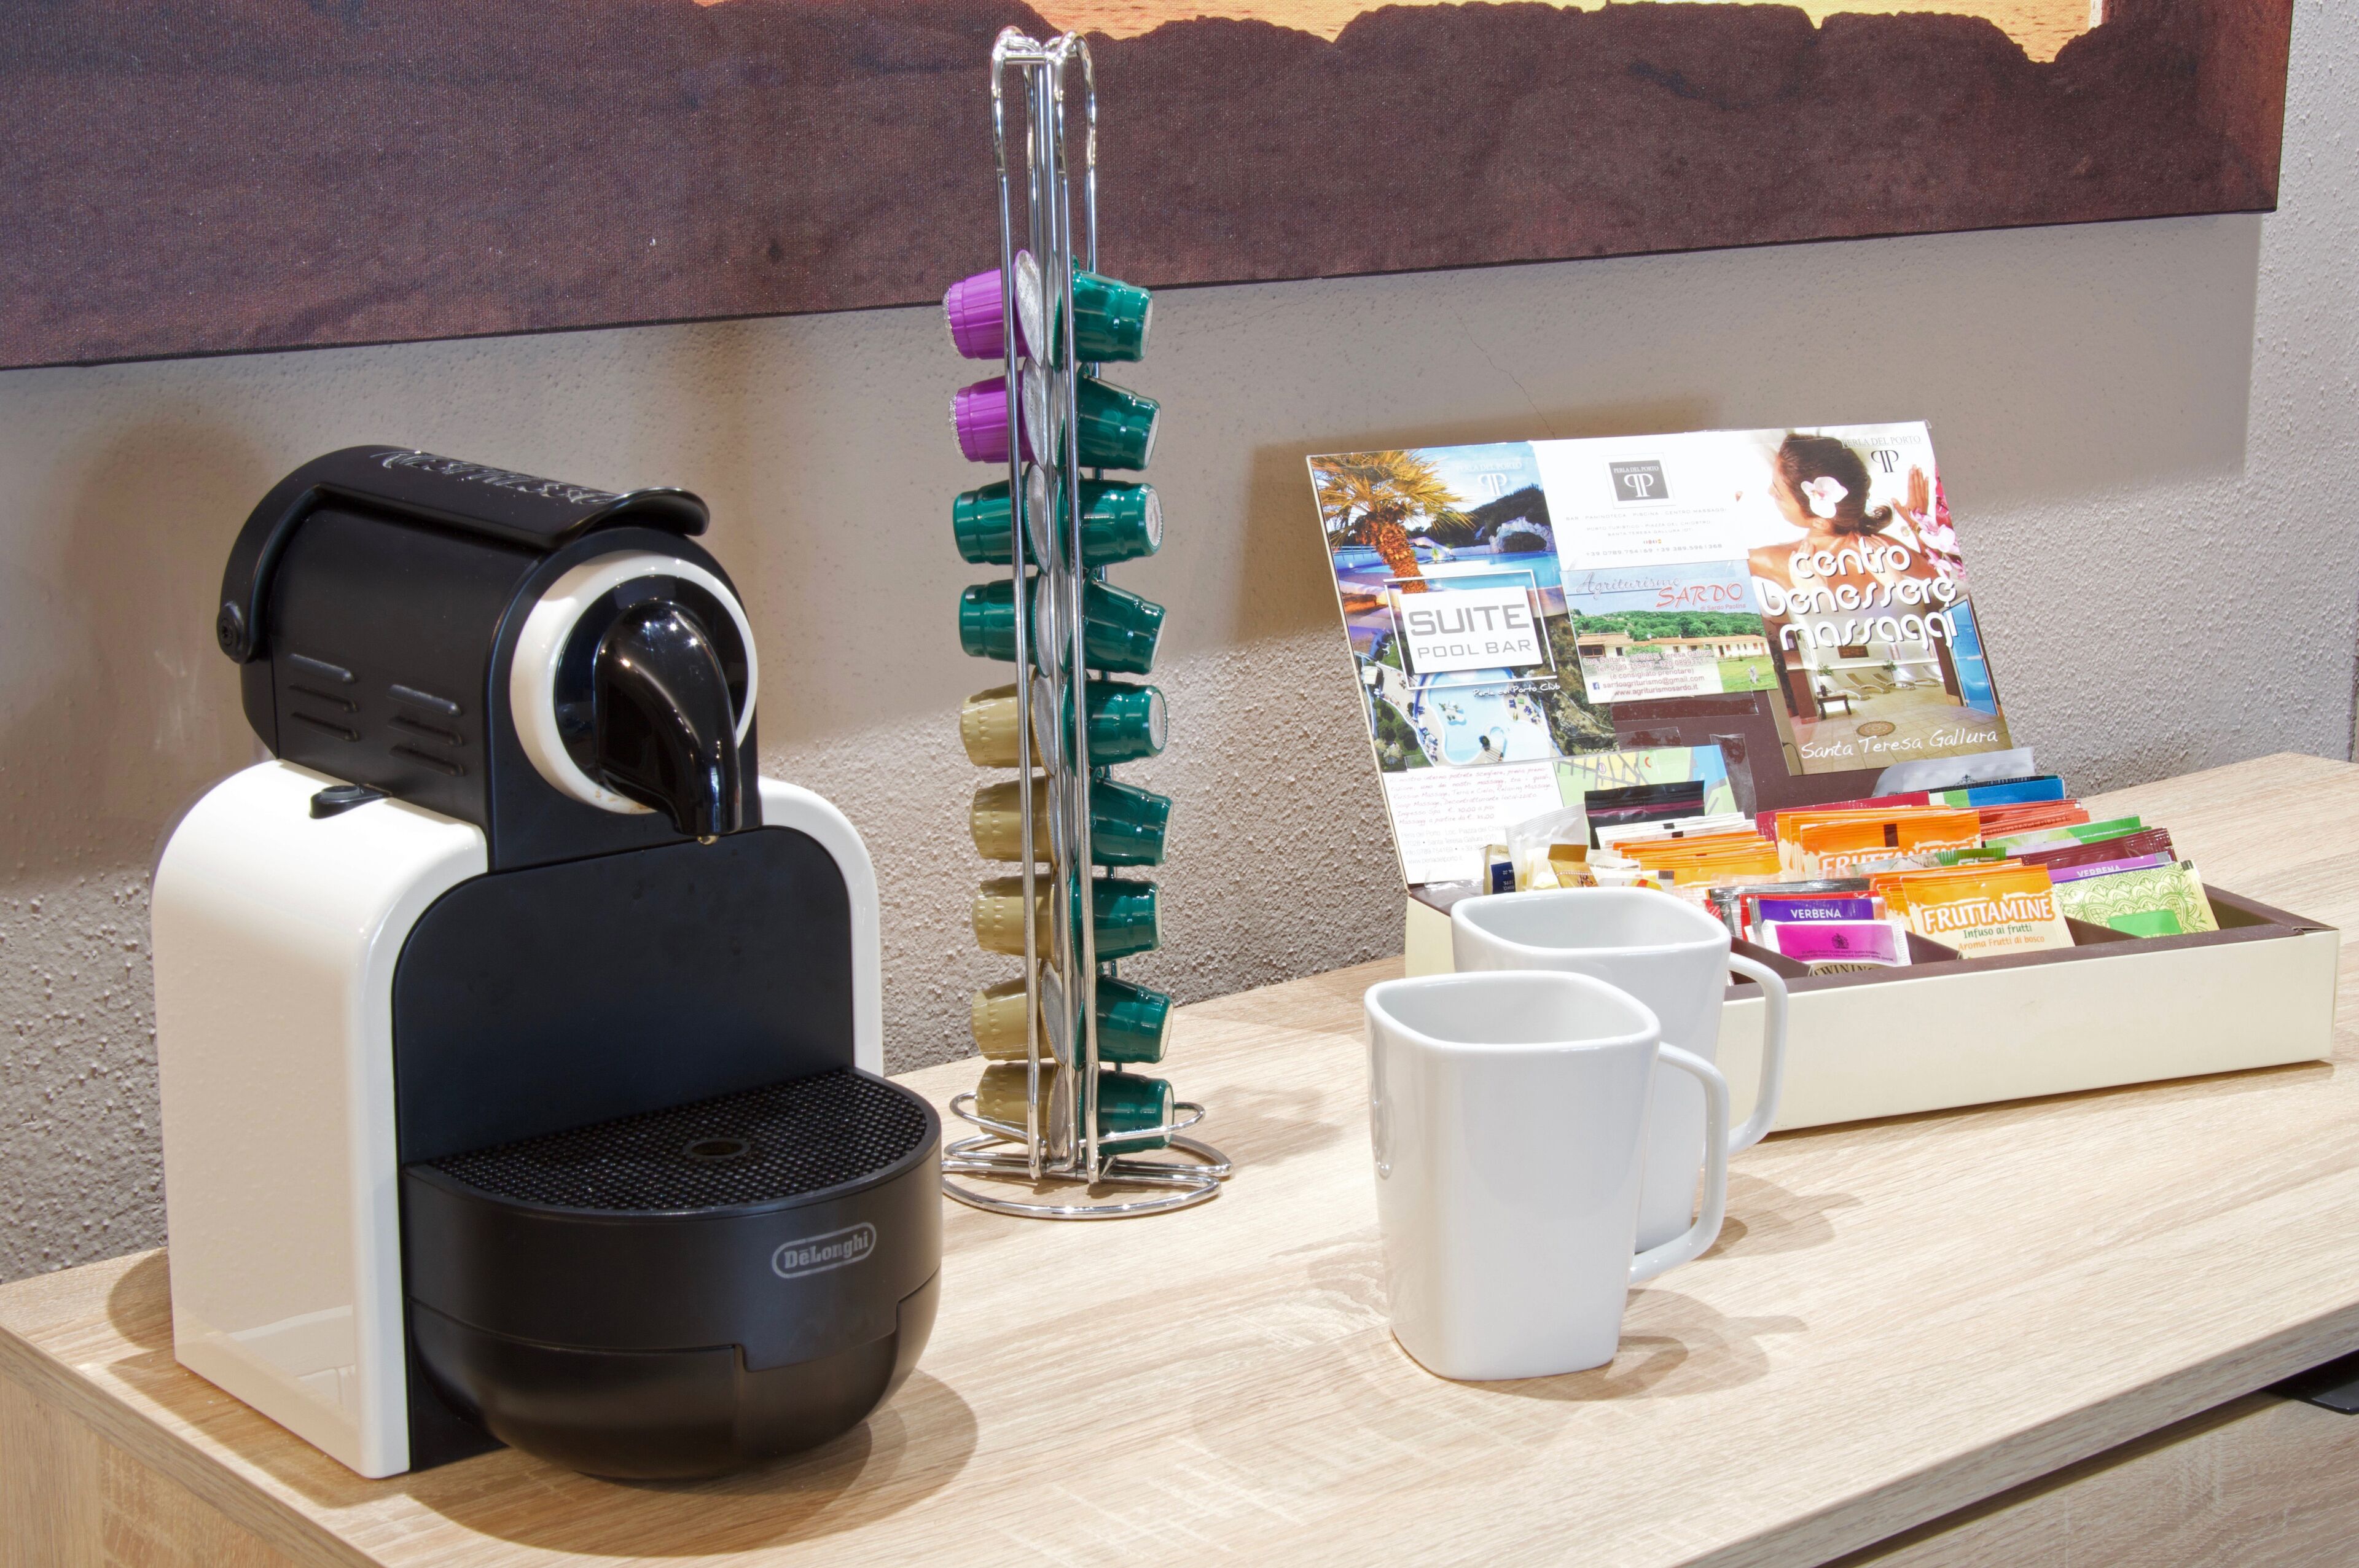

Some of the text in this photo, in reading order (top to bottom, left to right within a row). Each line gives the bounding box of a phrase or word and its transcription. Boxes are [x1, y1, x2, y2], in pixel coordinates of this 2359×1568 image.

[1871, 437, 1890, 445] DEL
[1890, 435, 1921, 444] PORTO
[1793, 536, 1910, 579] centro
[1576, 572, 1683, 600] Agriturismo
[1656, 583, 1743, 608] SARDO
[1757, 576, 1957, 616] benessere
[1408, 604, 1530, 636] SUITE
[1779, 601, 1958, 650] massaggi
[1417, 639, 1532, 658] POOL BAR
[1658, 668, 1694, 677] prenotare)
[1513, 684, 1537, 693] Porto
[1539, 682, 1561, 692] Club
[1614, 684, 1699, 695] www.agriturismosardo.it
[1801, 728, 1998, 759] Santa Teresa Gallura
[1791, 908, 1842, 919] VERBENA
[1923, 897, 2054, 932] FRUTTAMINE
[1963, 923, 2032, 939] Infuso ai frutti
[1958, 941, 1986, 951] Aroma
[1989, 937, 2013, 946] Frutti
[2024, 935, 2045, 944] bosco
